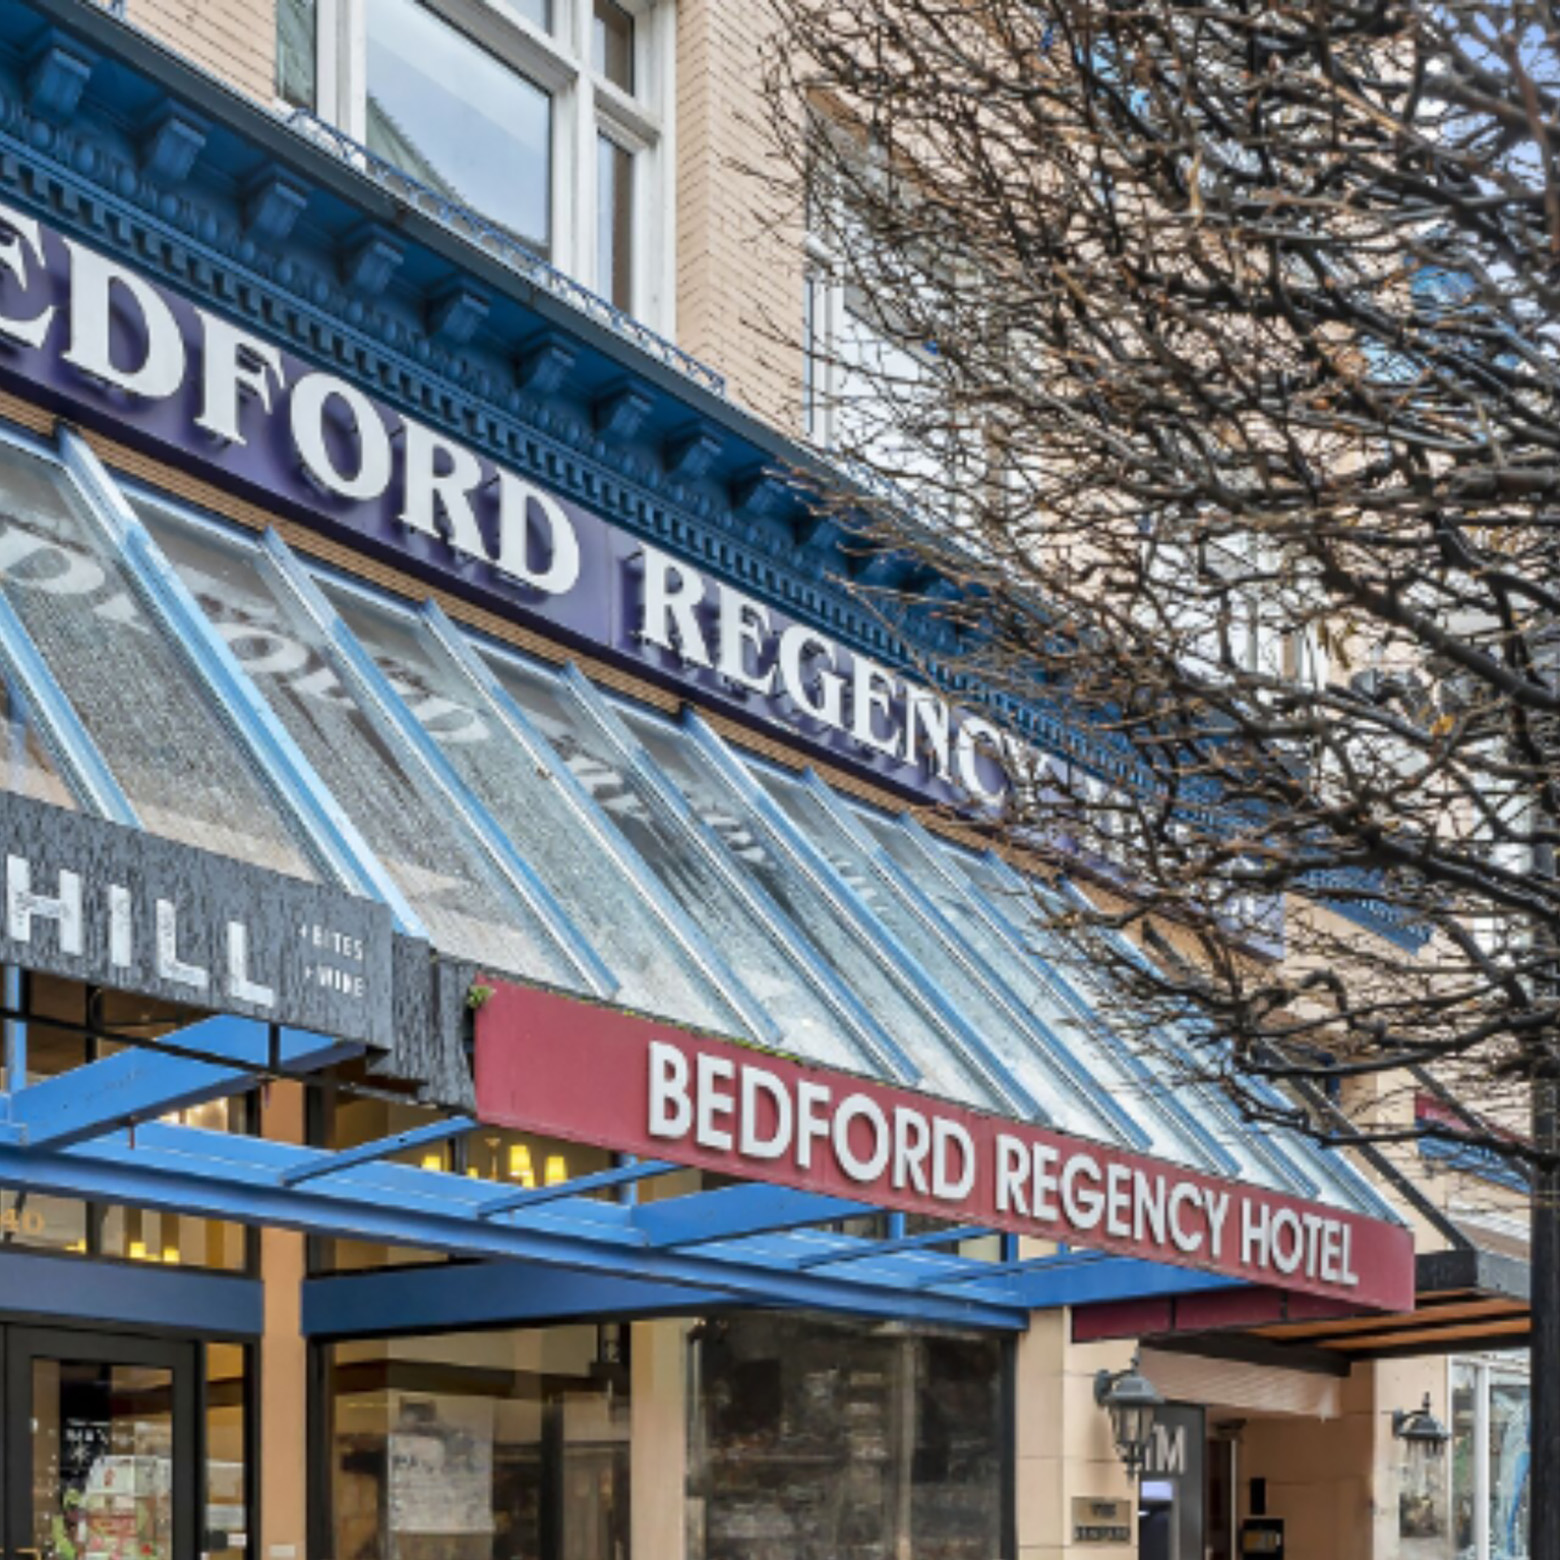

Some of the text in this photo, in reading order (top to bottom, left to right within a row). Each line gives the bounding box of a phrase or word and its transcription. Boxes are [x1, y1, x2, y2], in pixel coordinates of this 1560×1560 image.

[647, 1040, 1360, 1287] BEDFORD REGENCY HOTEL
